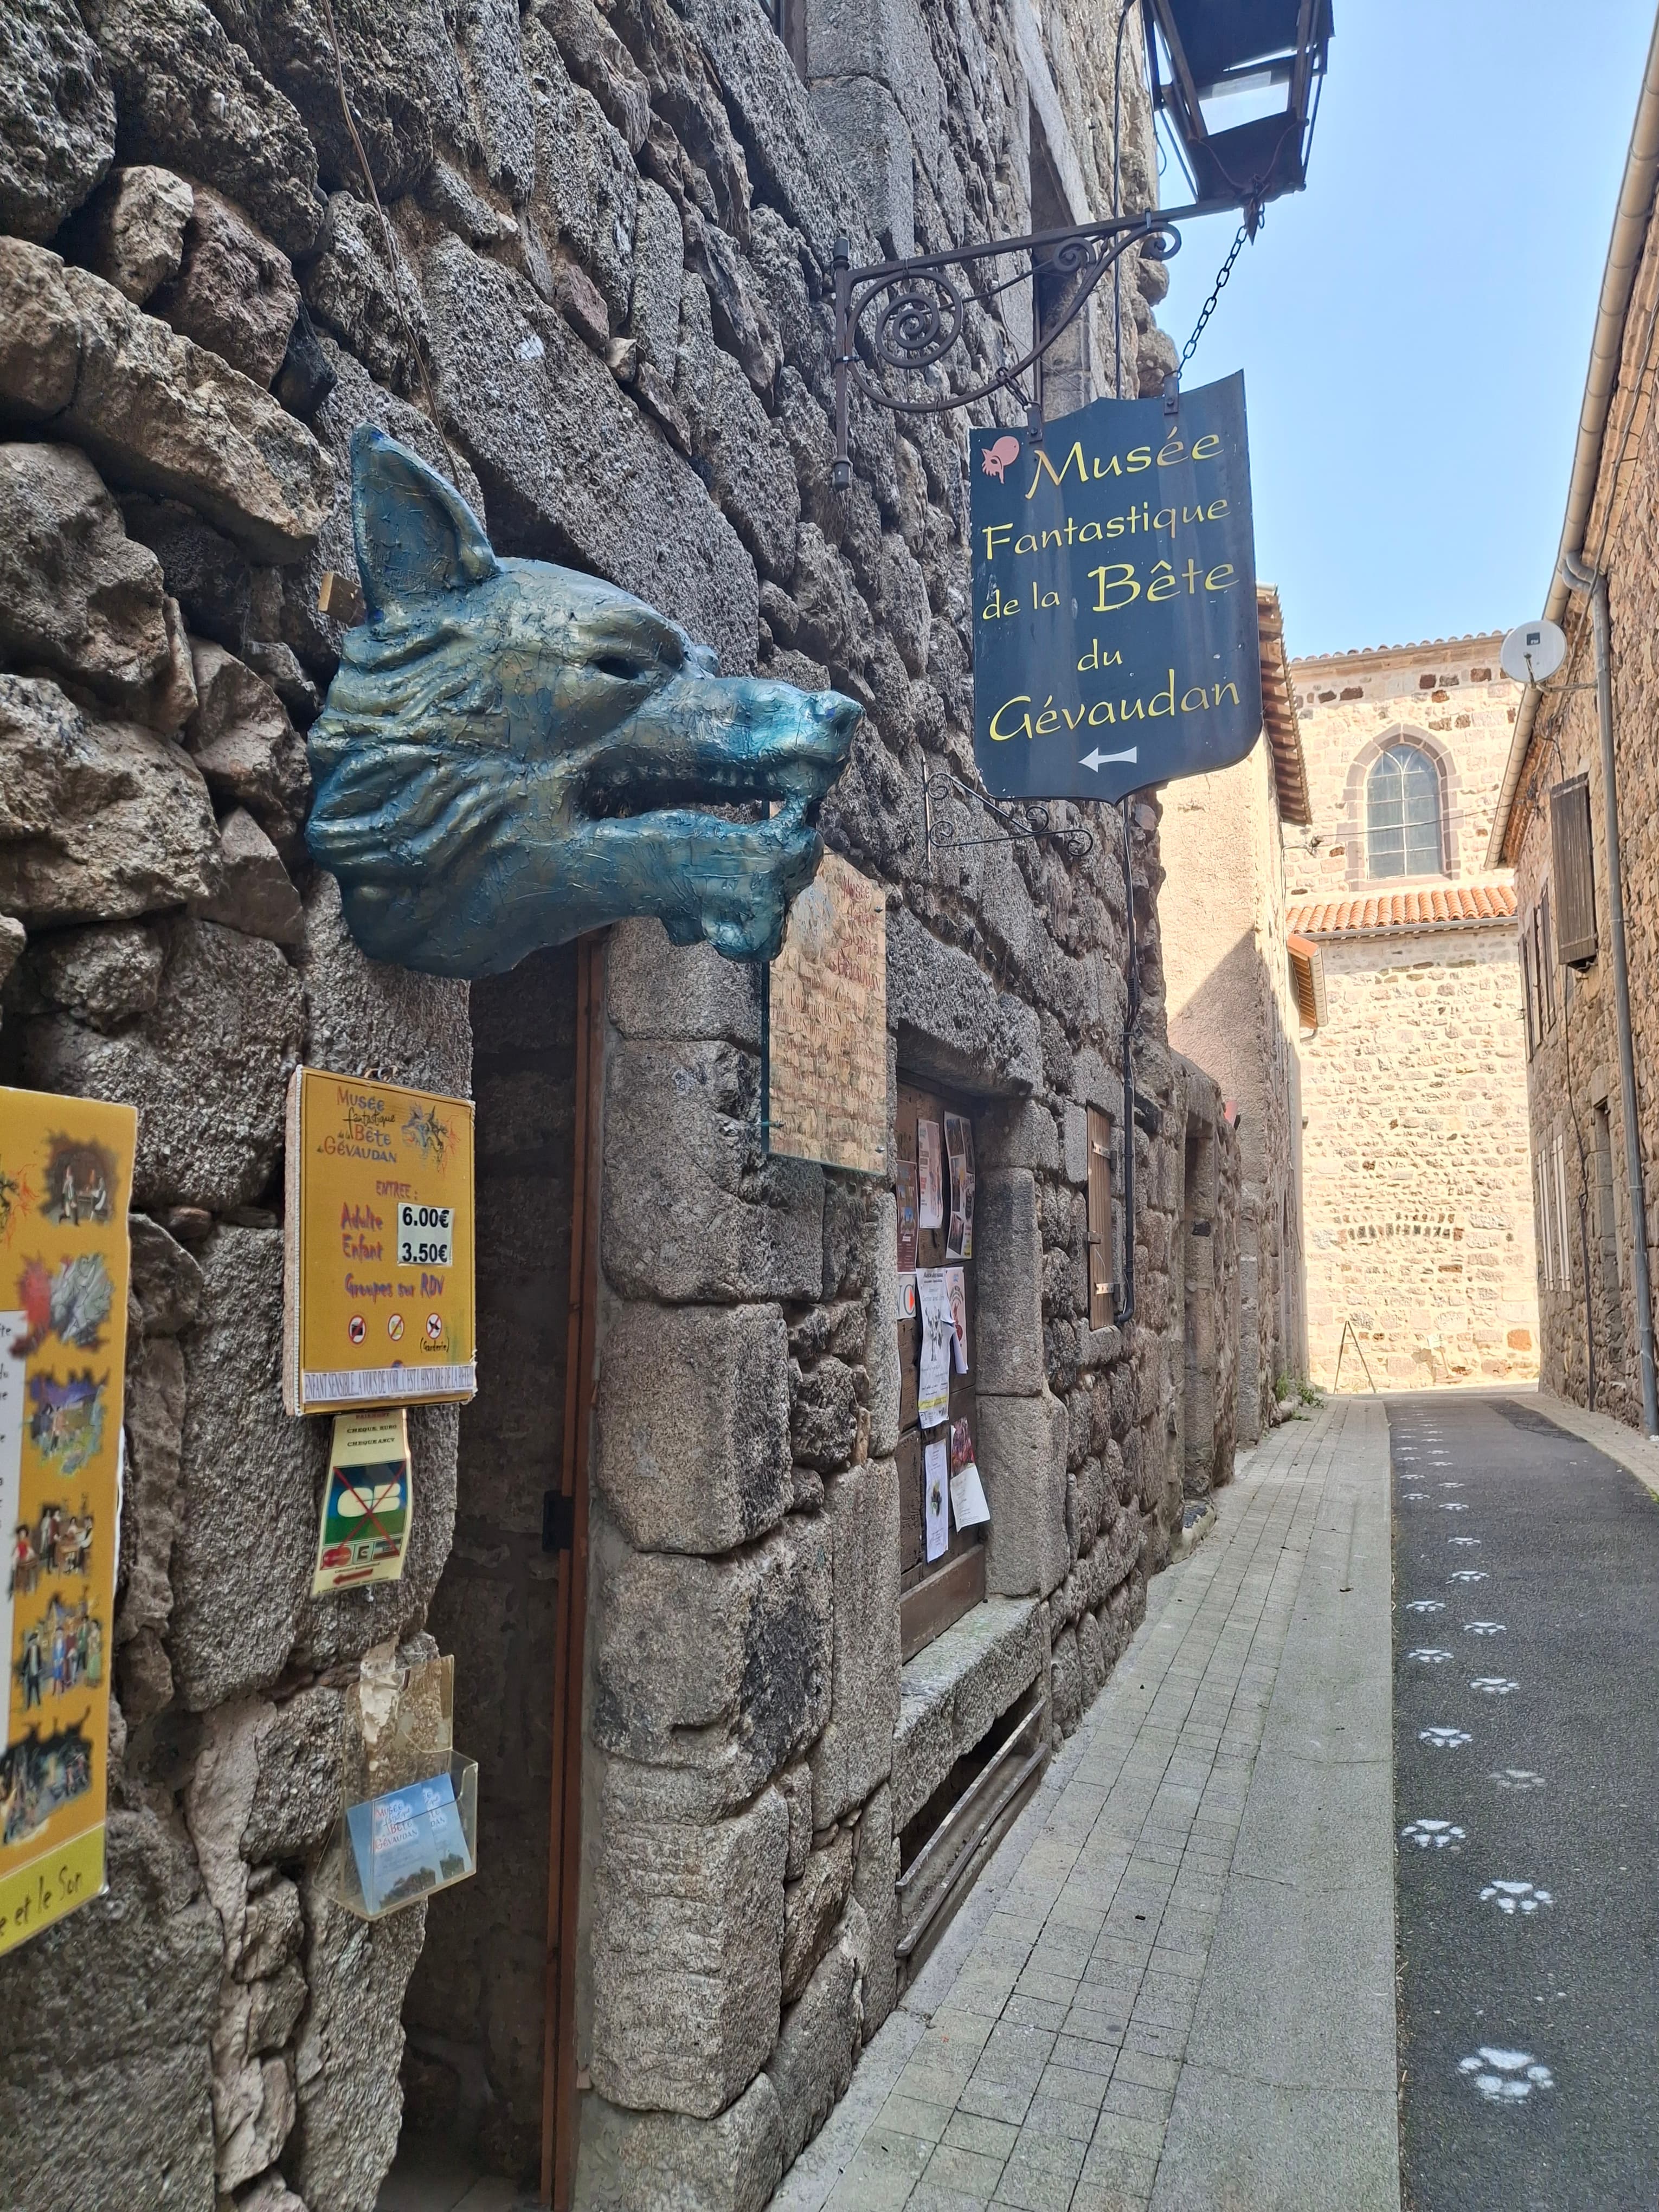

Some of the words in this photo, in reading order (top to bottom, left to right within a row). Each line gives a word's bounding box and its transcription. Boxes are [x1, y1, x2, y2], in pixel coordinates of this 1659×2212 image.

[1025, 427, 1224, 499] Musée
[982, 498, 1231, 560] Fantastique
[982, 589, 1020, 621] de
[1032, 582, 1060, 609] la
[1087, 558, 1240, 613] Bête
[1077, 638, 1123, 672] du
[989, 669, 1240, 742] Gévaudan
[340, 1201, 383, 1232] Adulte
[403, 1207, 449, 1228] 6.00€
[342, 1233, 383, 1262] Enfant
[402, 1242, 448, 1262] 3.50€
[345, 1272, 393, 1304] Groupes
[420, 1272, 445, 1299] RDV
[38, 1876, 52, 1913] le
